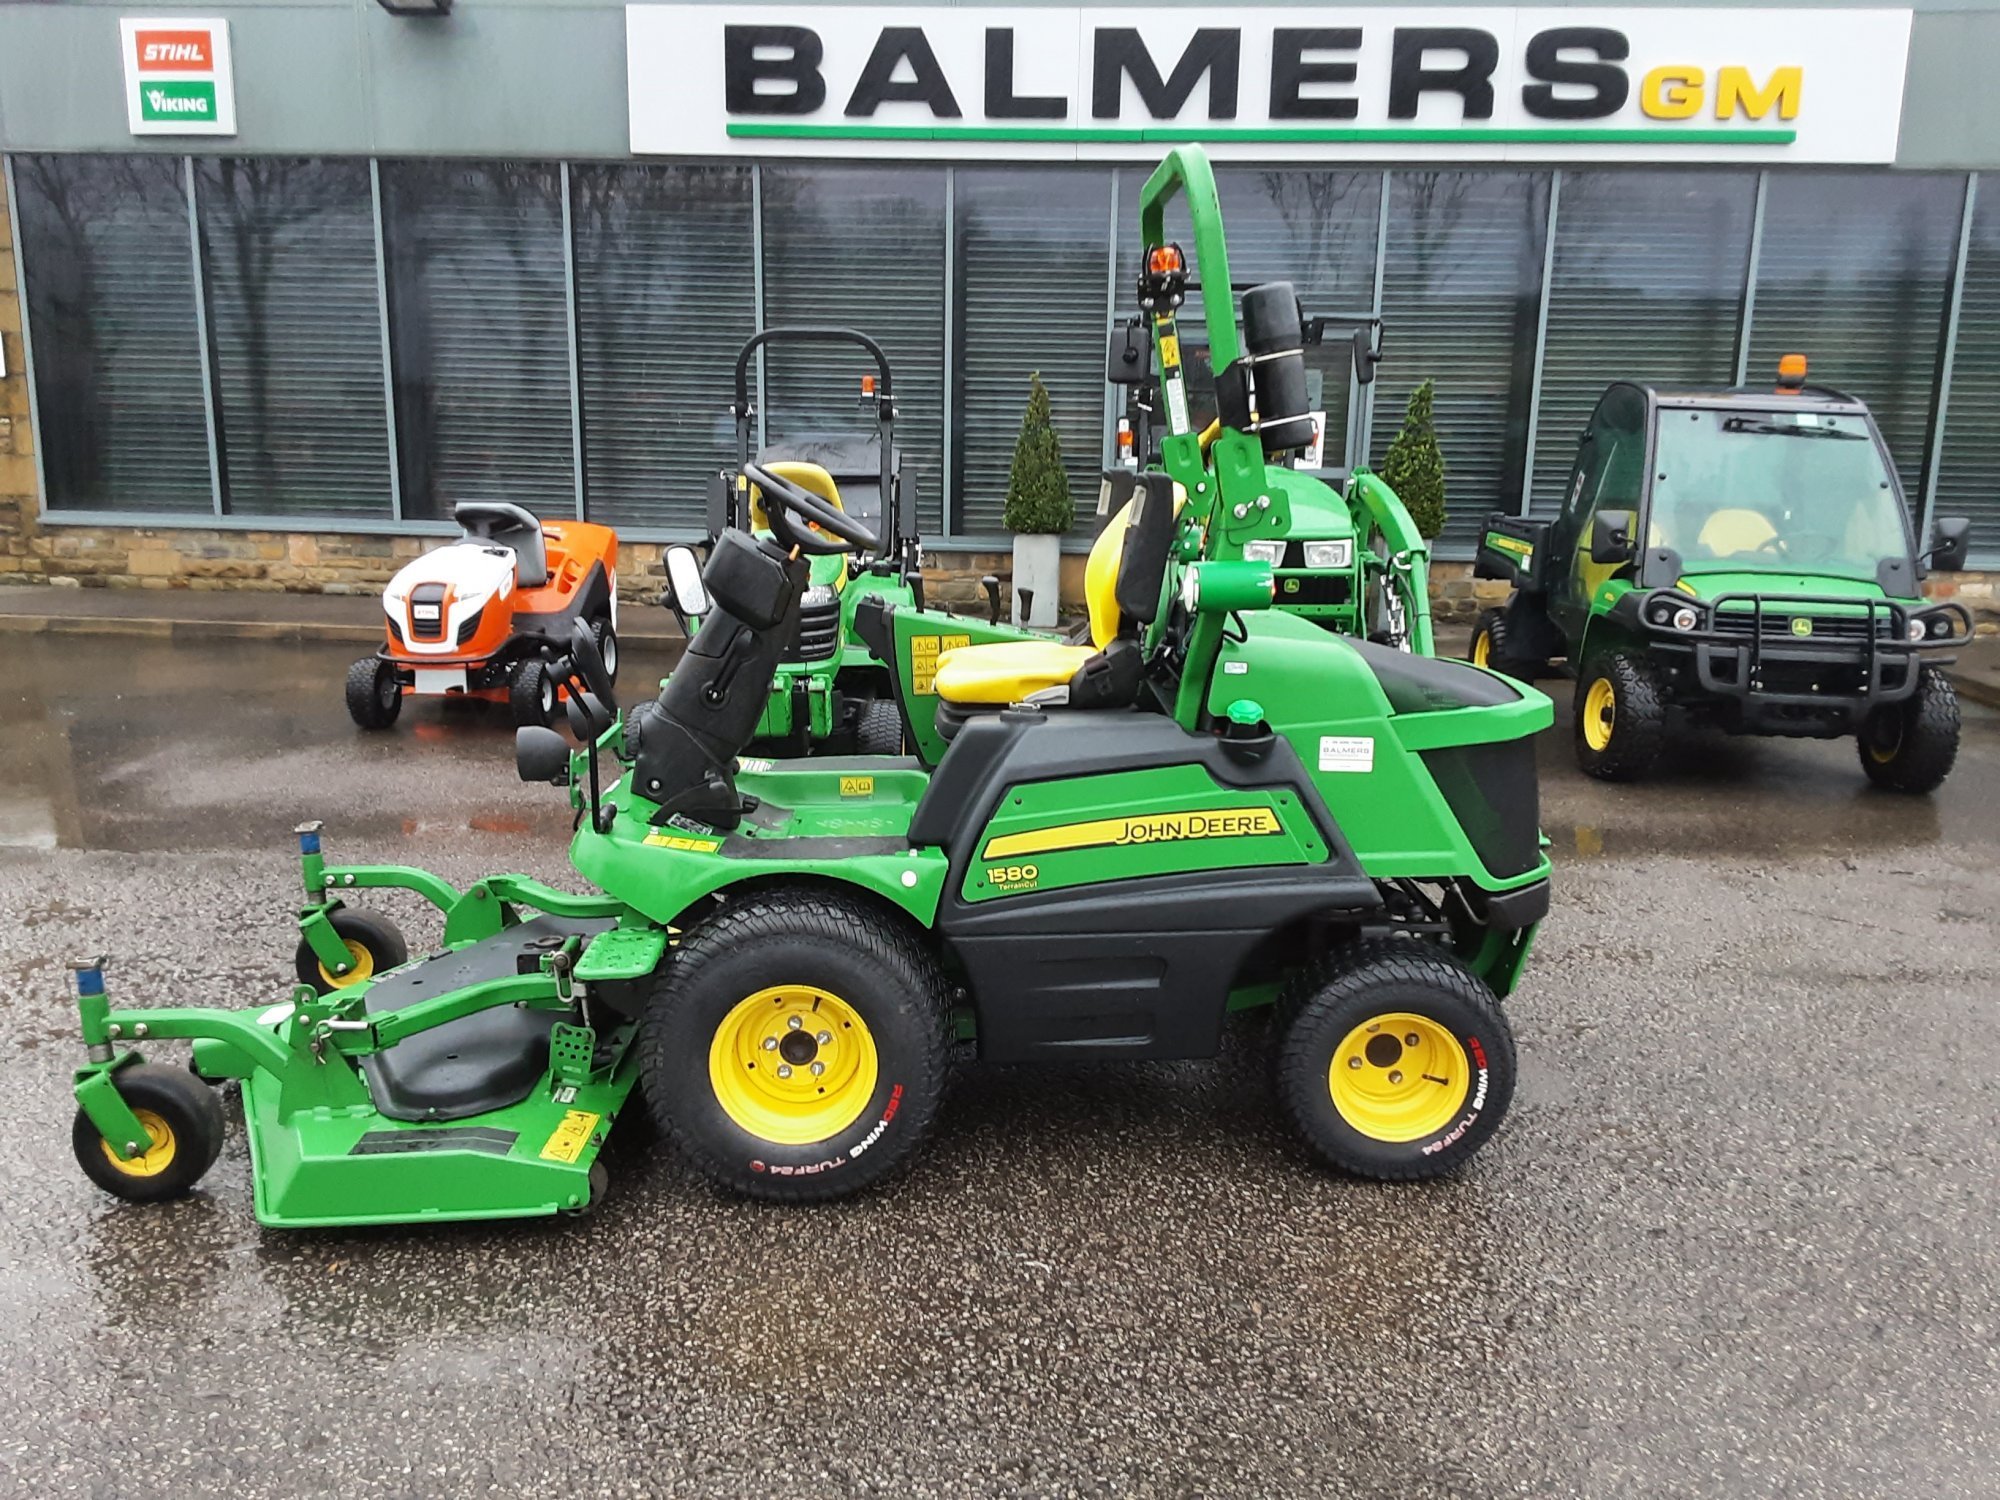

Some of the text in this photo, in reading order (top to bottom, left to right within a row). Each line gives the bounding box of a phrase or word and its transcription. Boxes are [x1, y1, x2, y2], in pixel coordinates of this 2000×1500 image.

[143, 43, 204, 61] STIHL
[724, 24, 1803, 120] BALMERS GM
[147, 92, 209, 113] VIKING
[1116, 816, 1268, 841] JOHN DEERE
[986, 864, 1038, 884] 1580
[998, 880, 1038, 891] TerrainCut
[769, 1156, 846, 1176] TURF24
